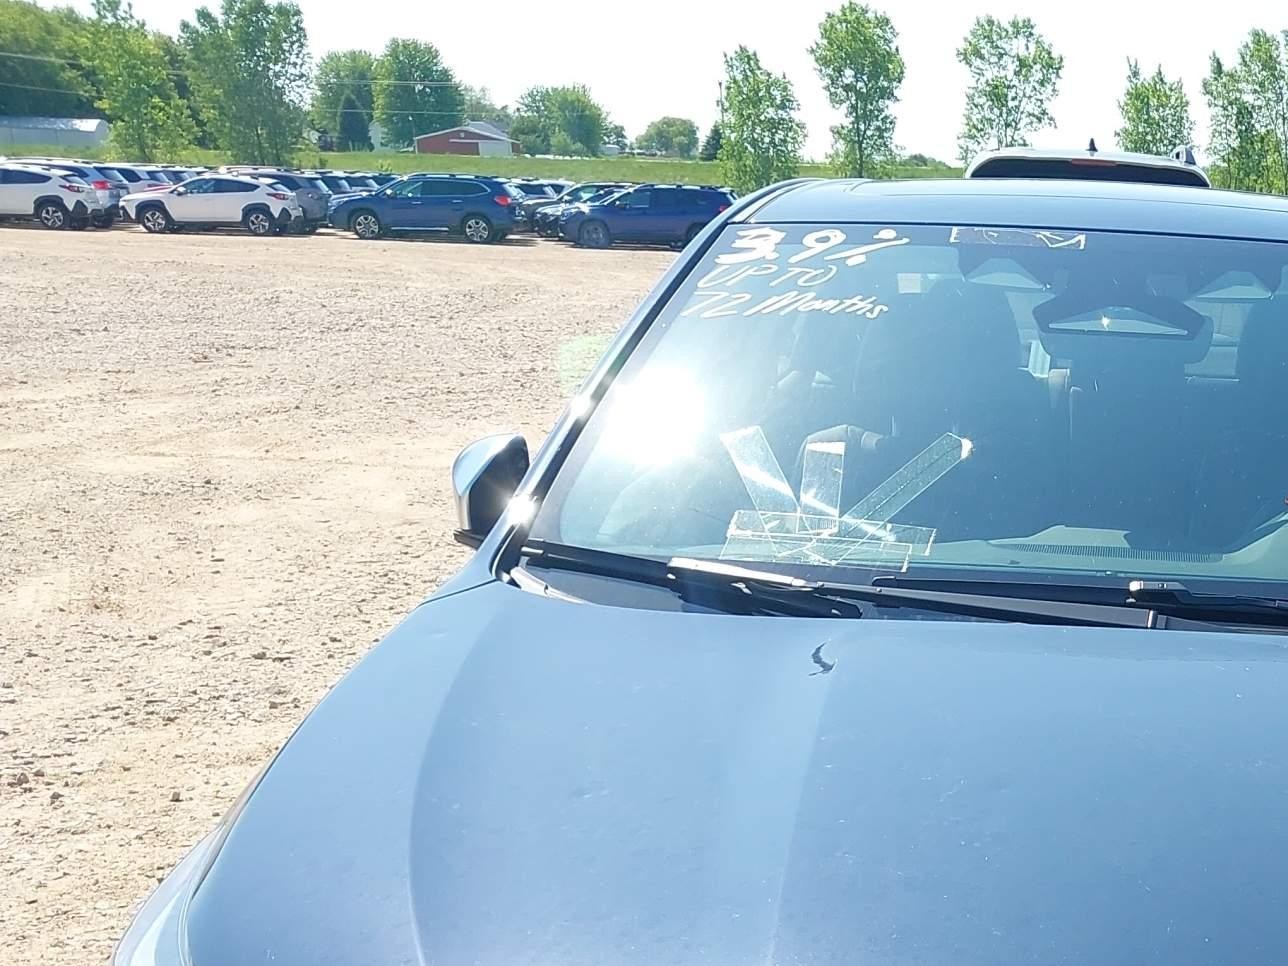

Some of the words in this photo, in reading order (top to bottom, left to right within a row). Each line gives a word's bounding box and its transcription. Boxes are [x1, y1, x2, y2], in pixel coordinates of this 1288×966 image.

[697, 264, 779, 289] UP
[768, 265, 838, 287] TO
[679, 291, 752, 318] 72
[743, 290, 889, 320] Months
